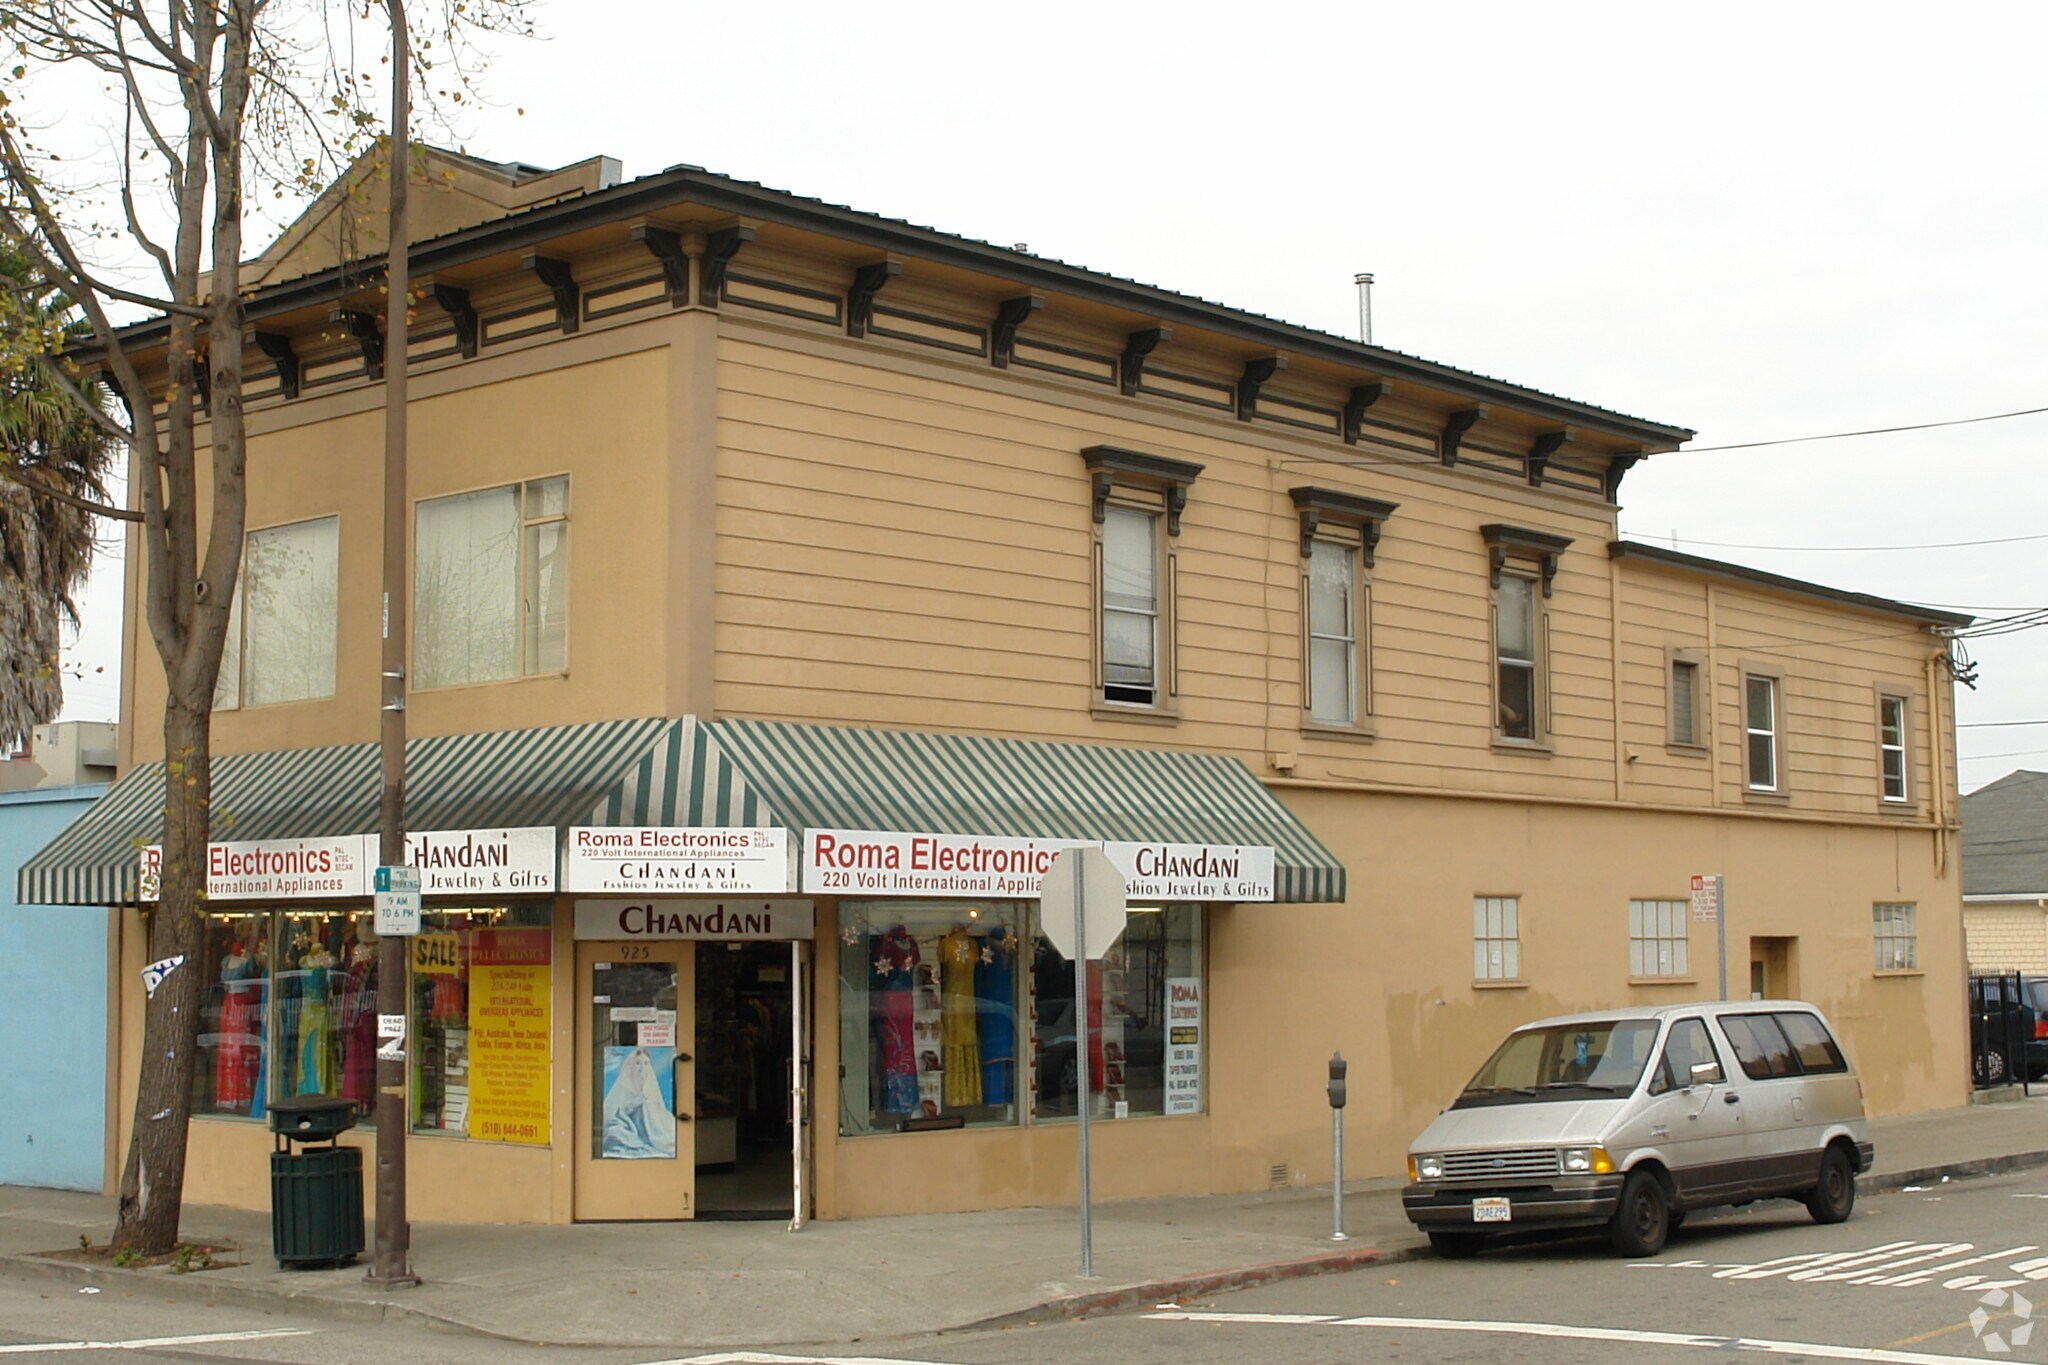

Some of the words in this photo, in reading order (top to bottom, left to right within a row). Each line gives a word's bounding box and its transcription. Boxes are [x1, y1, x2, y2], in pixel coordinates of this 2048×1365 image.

[578, 831, 633, 847] Roma
[641, 831, 749, 847] Electronics
[581, 849, 598, 857] 220
[602, 849, 621, 857] Volt
[624, 849, 687, 857] International
[690, 849, 745, 858] Appliances
[815, 834, 900, 869] Roma
[210, 843, 331, 876] Electronics
[210, 878, 272, 894] ternational
[276, 877, 343, 895] Appliances
[492, 872, 501, 887] &
[707, 881, 714, 889] &
[823, 872, 849, 887] 220
[857, 872, 887, 889] Volt
[893, 873, 991, 891] International
[997, 876, 1041, 895] Applia
[1223, 882, 1231, 896] &
[396, 897, 408, 905] AM
[382, 909, 391, 918] TO
[403, 909, 414, 917] PM
[416, 939, 456, 967] SALE
[621, 945, 649, 960] 925
[1171, 984, 1199, 1002] ROMA
